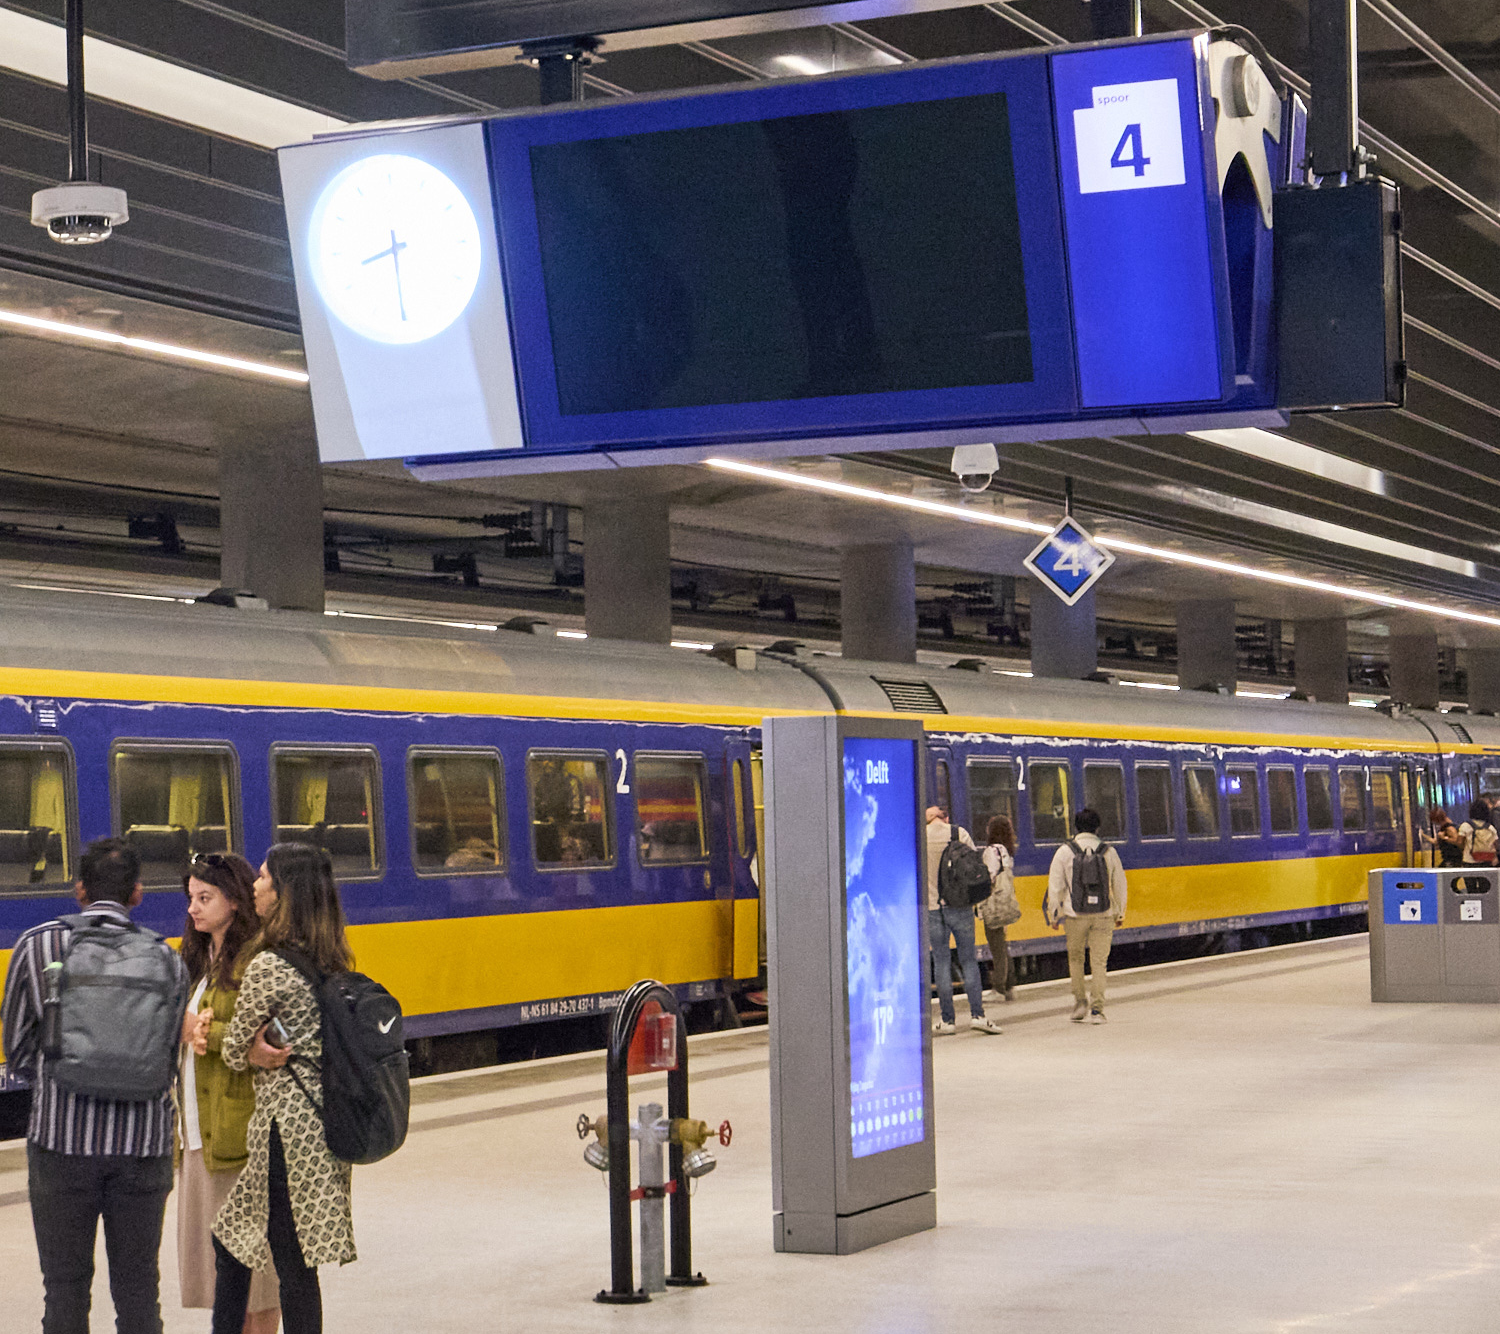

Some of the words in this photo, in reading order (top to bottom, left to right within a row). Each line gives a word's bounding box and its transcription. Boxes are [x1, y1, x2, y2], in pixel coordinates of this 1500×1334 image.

[1097, 94, 1130, 106] spoor
[1110, 123, 1151, 178] 4
[1053, 544, 1085, 577] 4
[615, 748, 630, 794] 2
[865, 758, 890, 785] Delft
[1015, 755, 1026, 791] 2
[1363, 765, 1371, 791] 2
